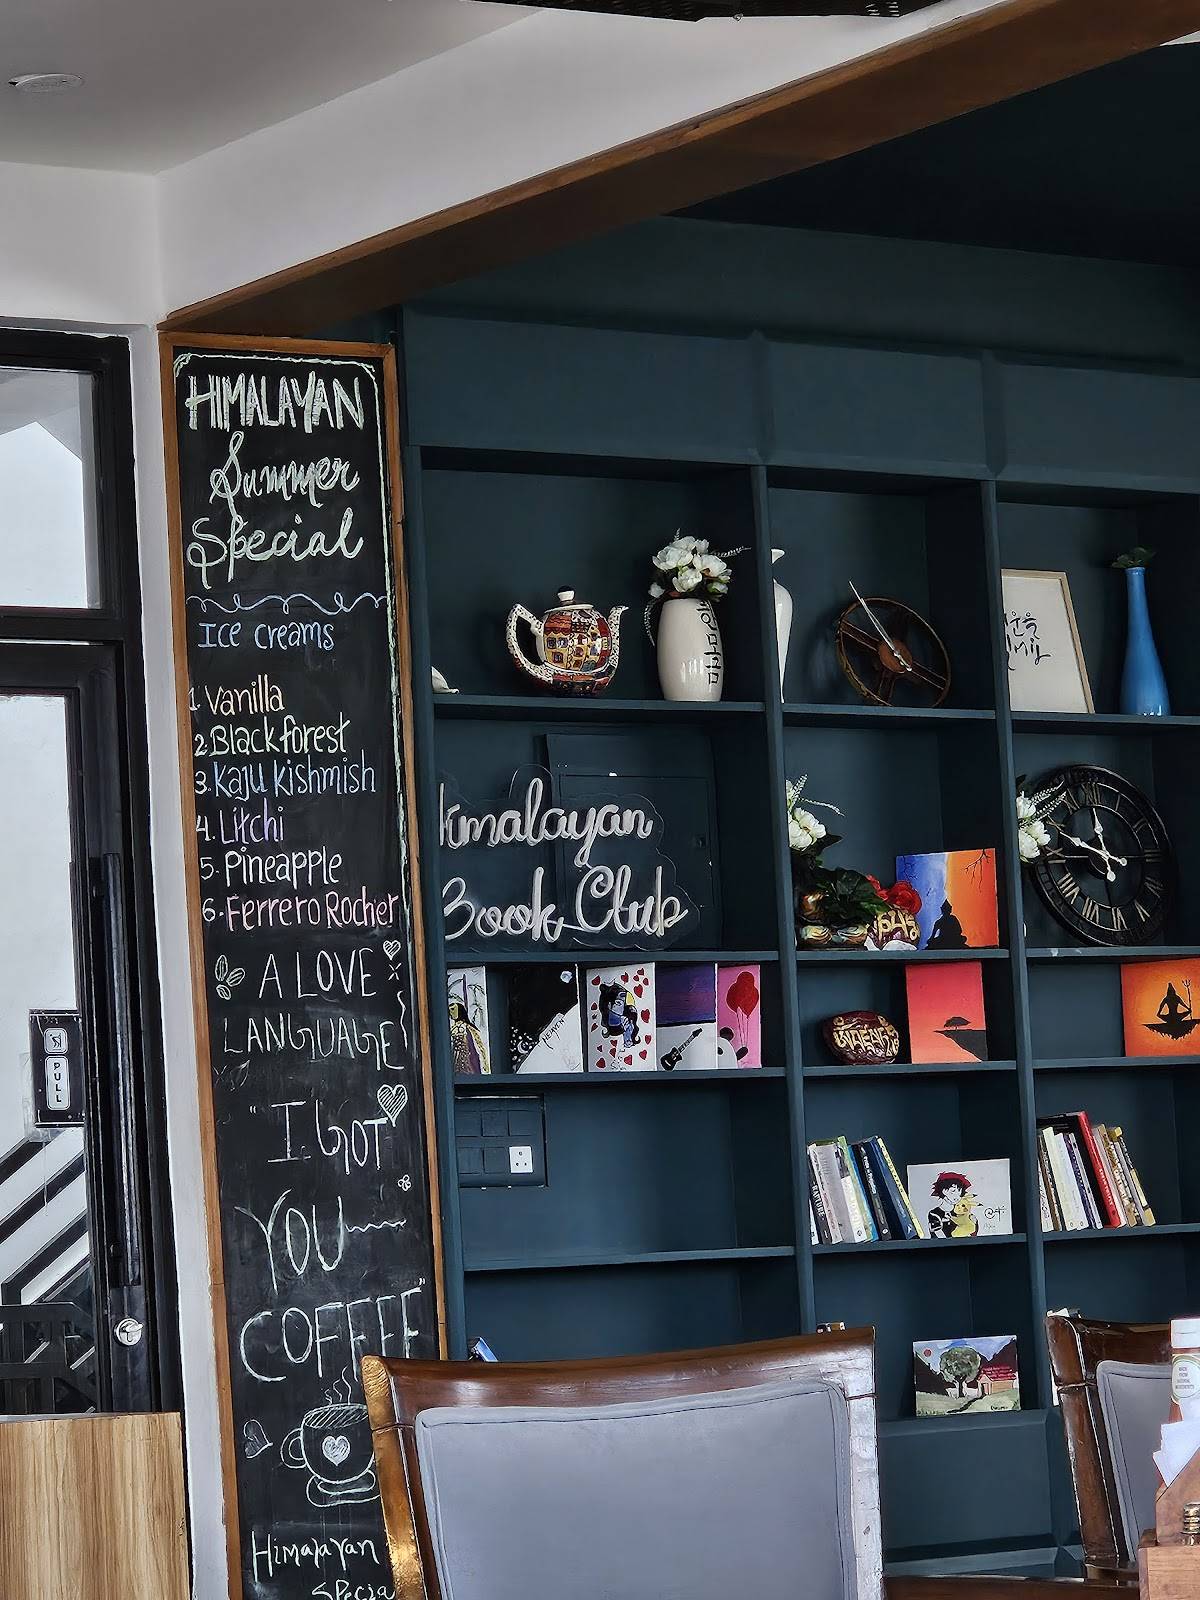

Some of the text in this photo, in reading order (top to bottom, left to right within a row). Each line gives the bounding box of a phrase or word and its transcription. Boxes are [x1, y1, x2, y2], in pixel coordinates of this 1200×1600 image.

[185, 371, 364, 433] HIMALAYAN
[209, 431, 360, 508] Summer
[186, 508, 364, 589] Special
[198, 621, 335, 650] Ice creams
[204, 674, 285, 716] Vanilla
[213, 761, 268, 802] Kaju
[219, 797, 285, 845] Litchi
[224, 846, 343, 890] Pineapple
[226, 894, 321, 931] Ferrero
[325, 886, 399, 928] Rocher
[575, 865, 689, 938] Club
[259, 947, 377, 999] A LOVE
[224, 1012, 405, 1071] LANGUAGE
[53, 1062, 62, 1103] PULL
[315, 1099, 389, 1175] GOT
[234, 1188, 344, 1296] YOU
[251, 1530, 380, 1583] Himalayan
[311, 1579, 396, 1600] Specia
